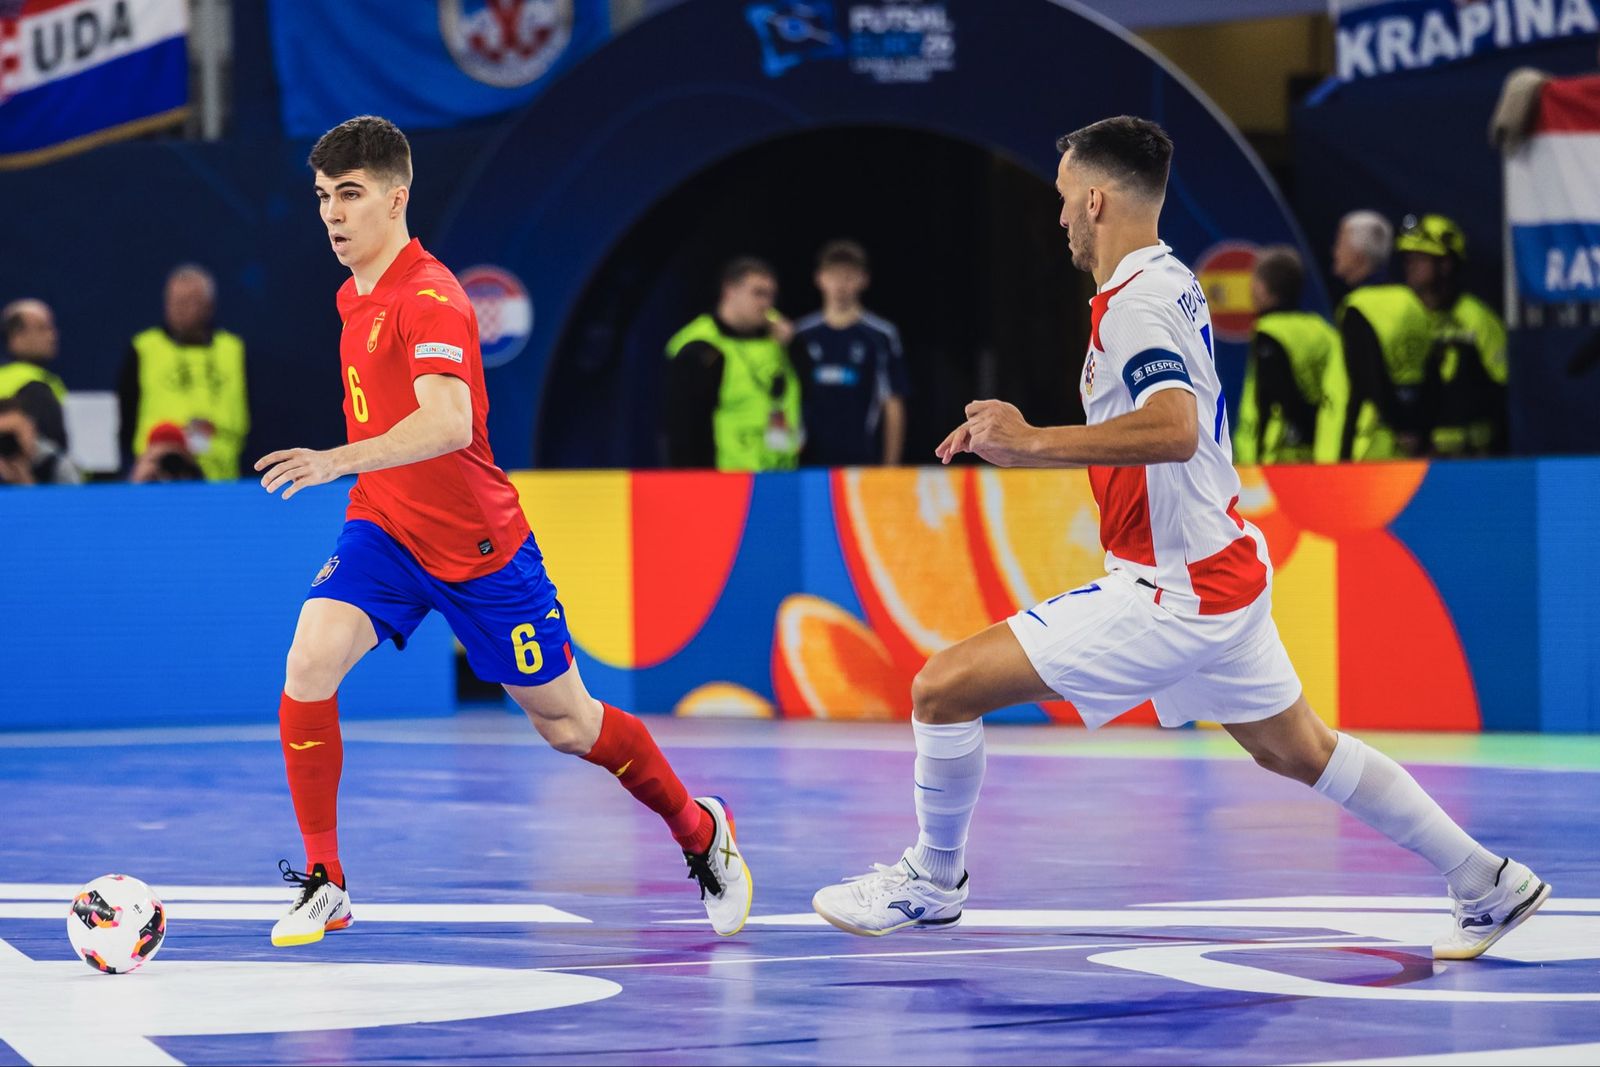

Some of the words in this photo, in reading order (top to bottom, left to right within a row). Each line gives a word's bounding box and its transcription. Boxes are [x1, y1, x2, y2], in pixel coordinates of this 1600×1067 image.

[33, 0, 132, 72] UDA
[1337, 0, 1599, 82] KRAPINA
[348, 365, 369, 423] 6
[1144, 361, 1184, 374] RESPECT
[511, 623, 544, 675] 6
